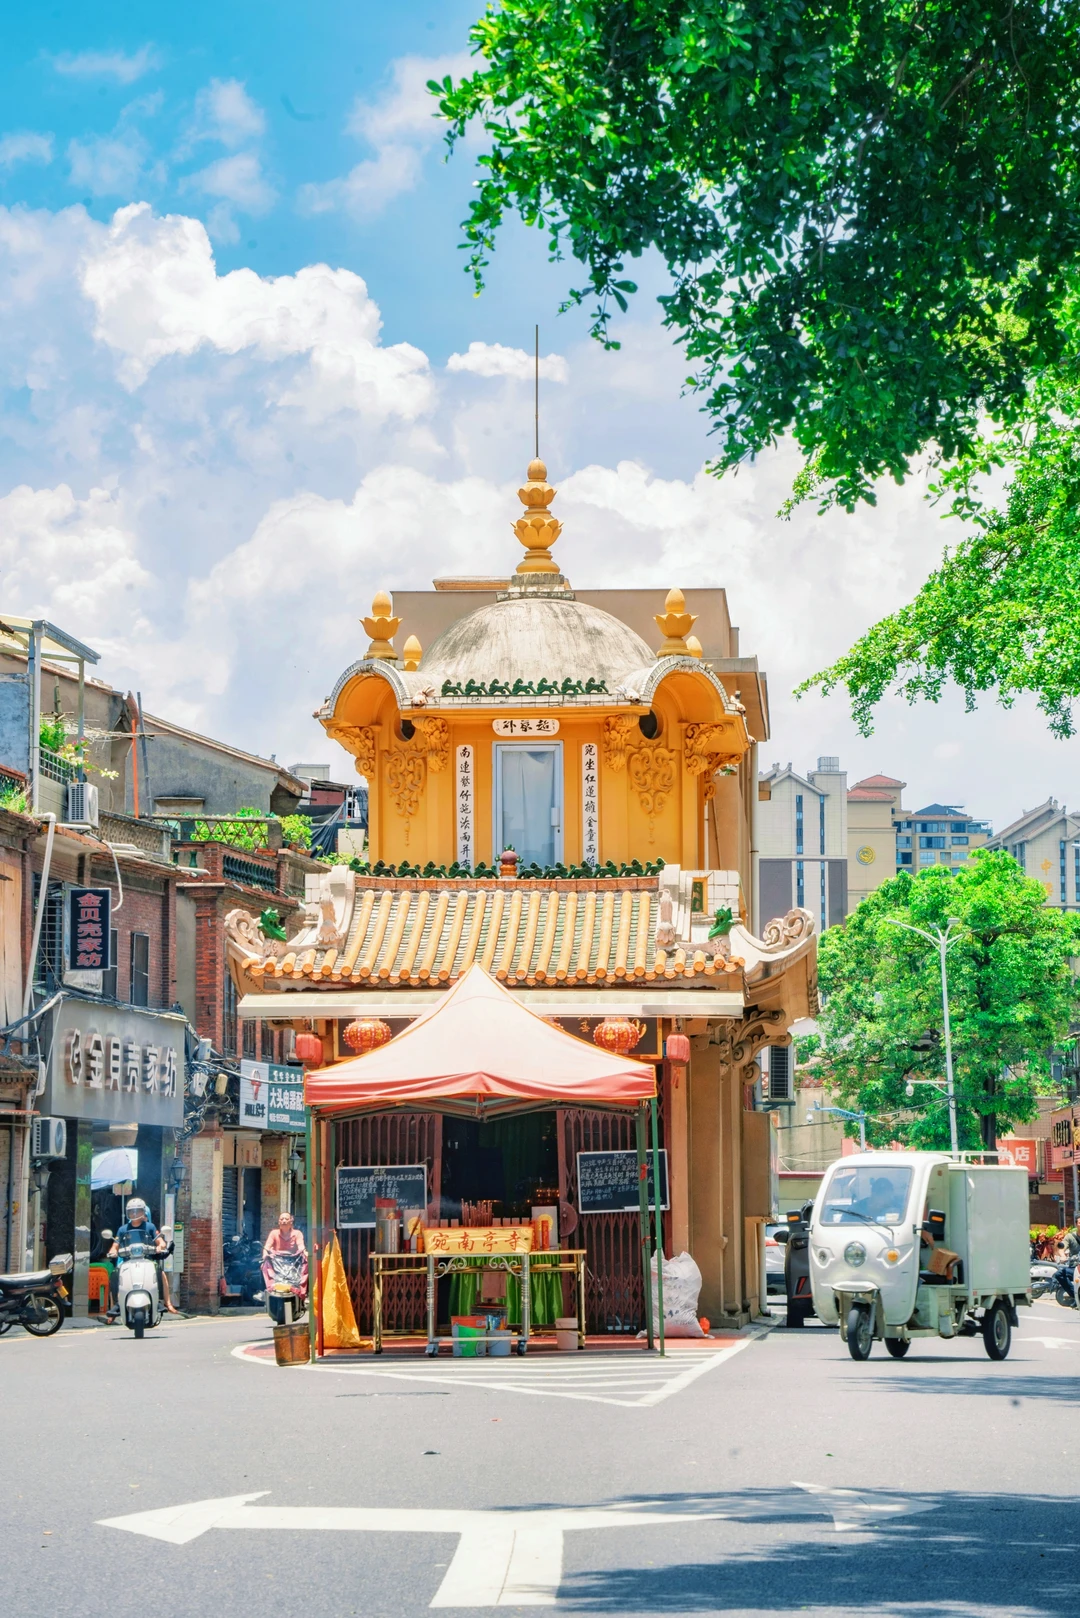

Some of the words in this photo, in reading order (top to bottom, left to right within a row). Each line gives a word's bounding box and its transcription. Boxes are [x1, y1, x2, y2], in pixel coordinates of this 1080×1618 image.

[76, 892, 103, 967] 金贝壳家纺
[269, 1087, 305, 1111] 大头电器配
[432, 1230, 521, 1252] 宛南亭寺
